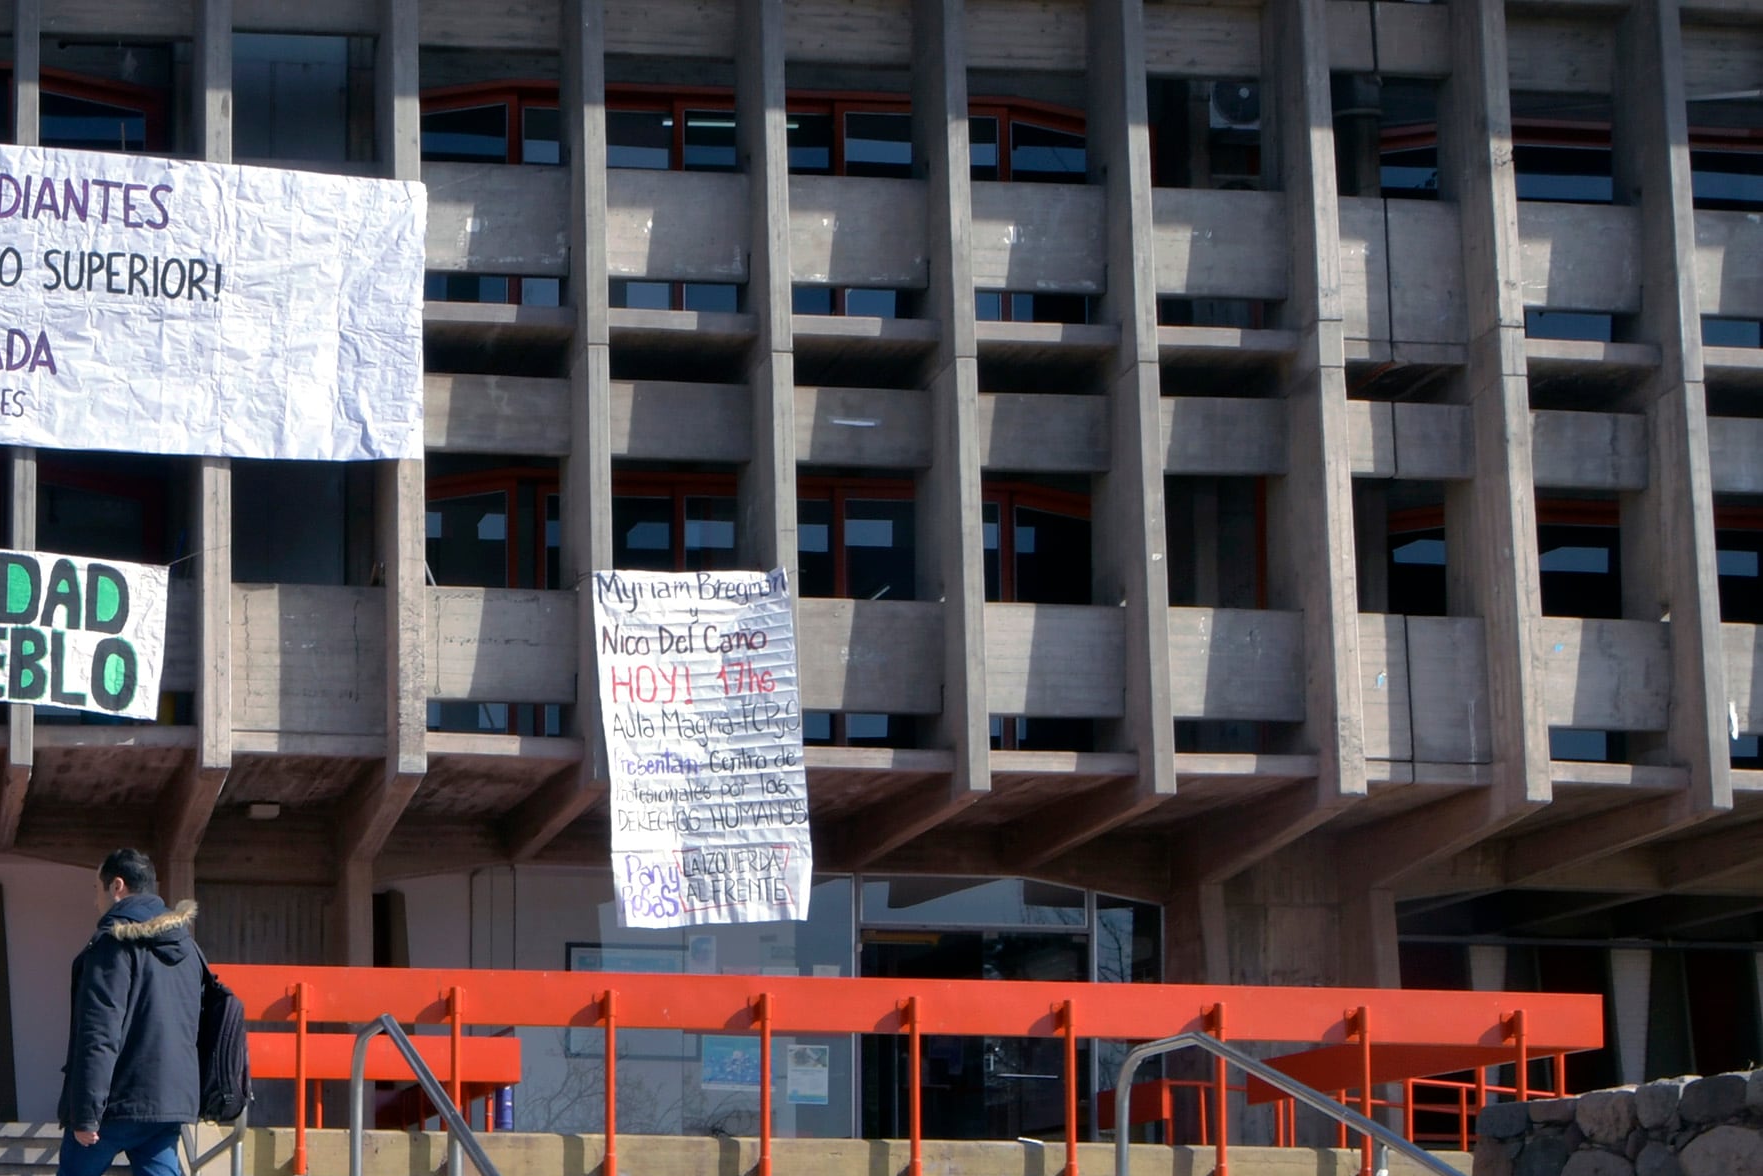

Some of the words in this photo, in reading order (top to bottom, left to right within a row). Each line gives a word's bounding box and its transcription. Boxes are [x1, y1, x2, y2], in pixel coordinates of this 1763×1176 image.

[43, 249, 222, 302] SUPERIOR!
[596, 572, 689, 613] Myriam
[696, 568, 786, 605] Bregman
[690, 607, 699, 624] y
[602, 624, 650, 655] Nico
[659, 625, 693, 655] Del
[703, 624, 767, 654] Caño
[611, 665, 694, 704] HOY!
[716, 661, 777, 695] 17hs
[613, 712, 655, 738] Aula
[709, 749, 767, 774] Centro
[774, 747, 797, 767] de
[616, 777, 711, 804] Profesionales
[721, 777, 748, 800] por
[618, 806, 701, 832] DERECHOS
[710, 799, 807, 830] HUMANOS
[625, 854, 665, 885] Pan
[669, 866, 680, 892] y
[622, 885, 680, 918] Rosas
[687, 881, 708, 902] AL
[712, 877, 787, 904] FRENTE
